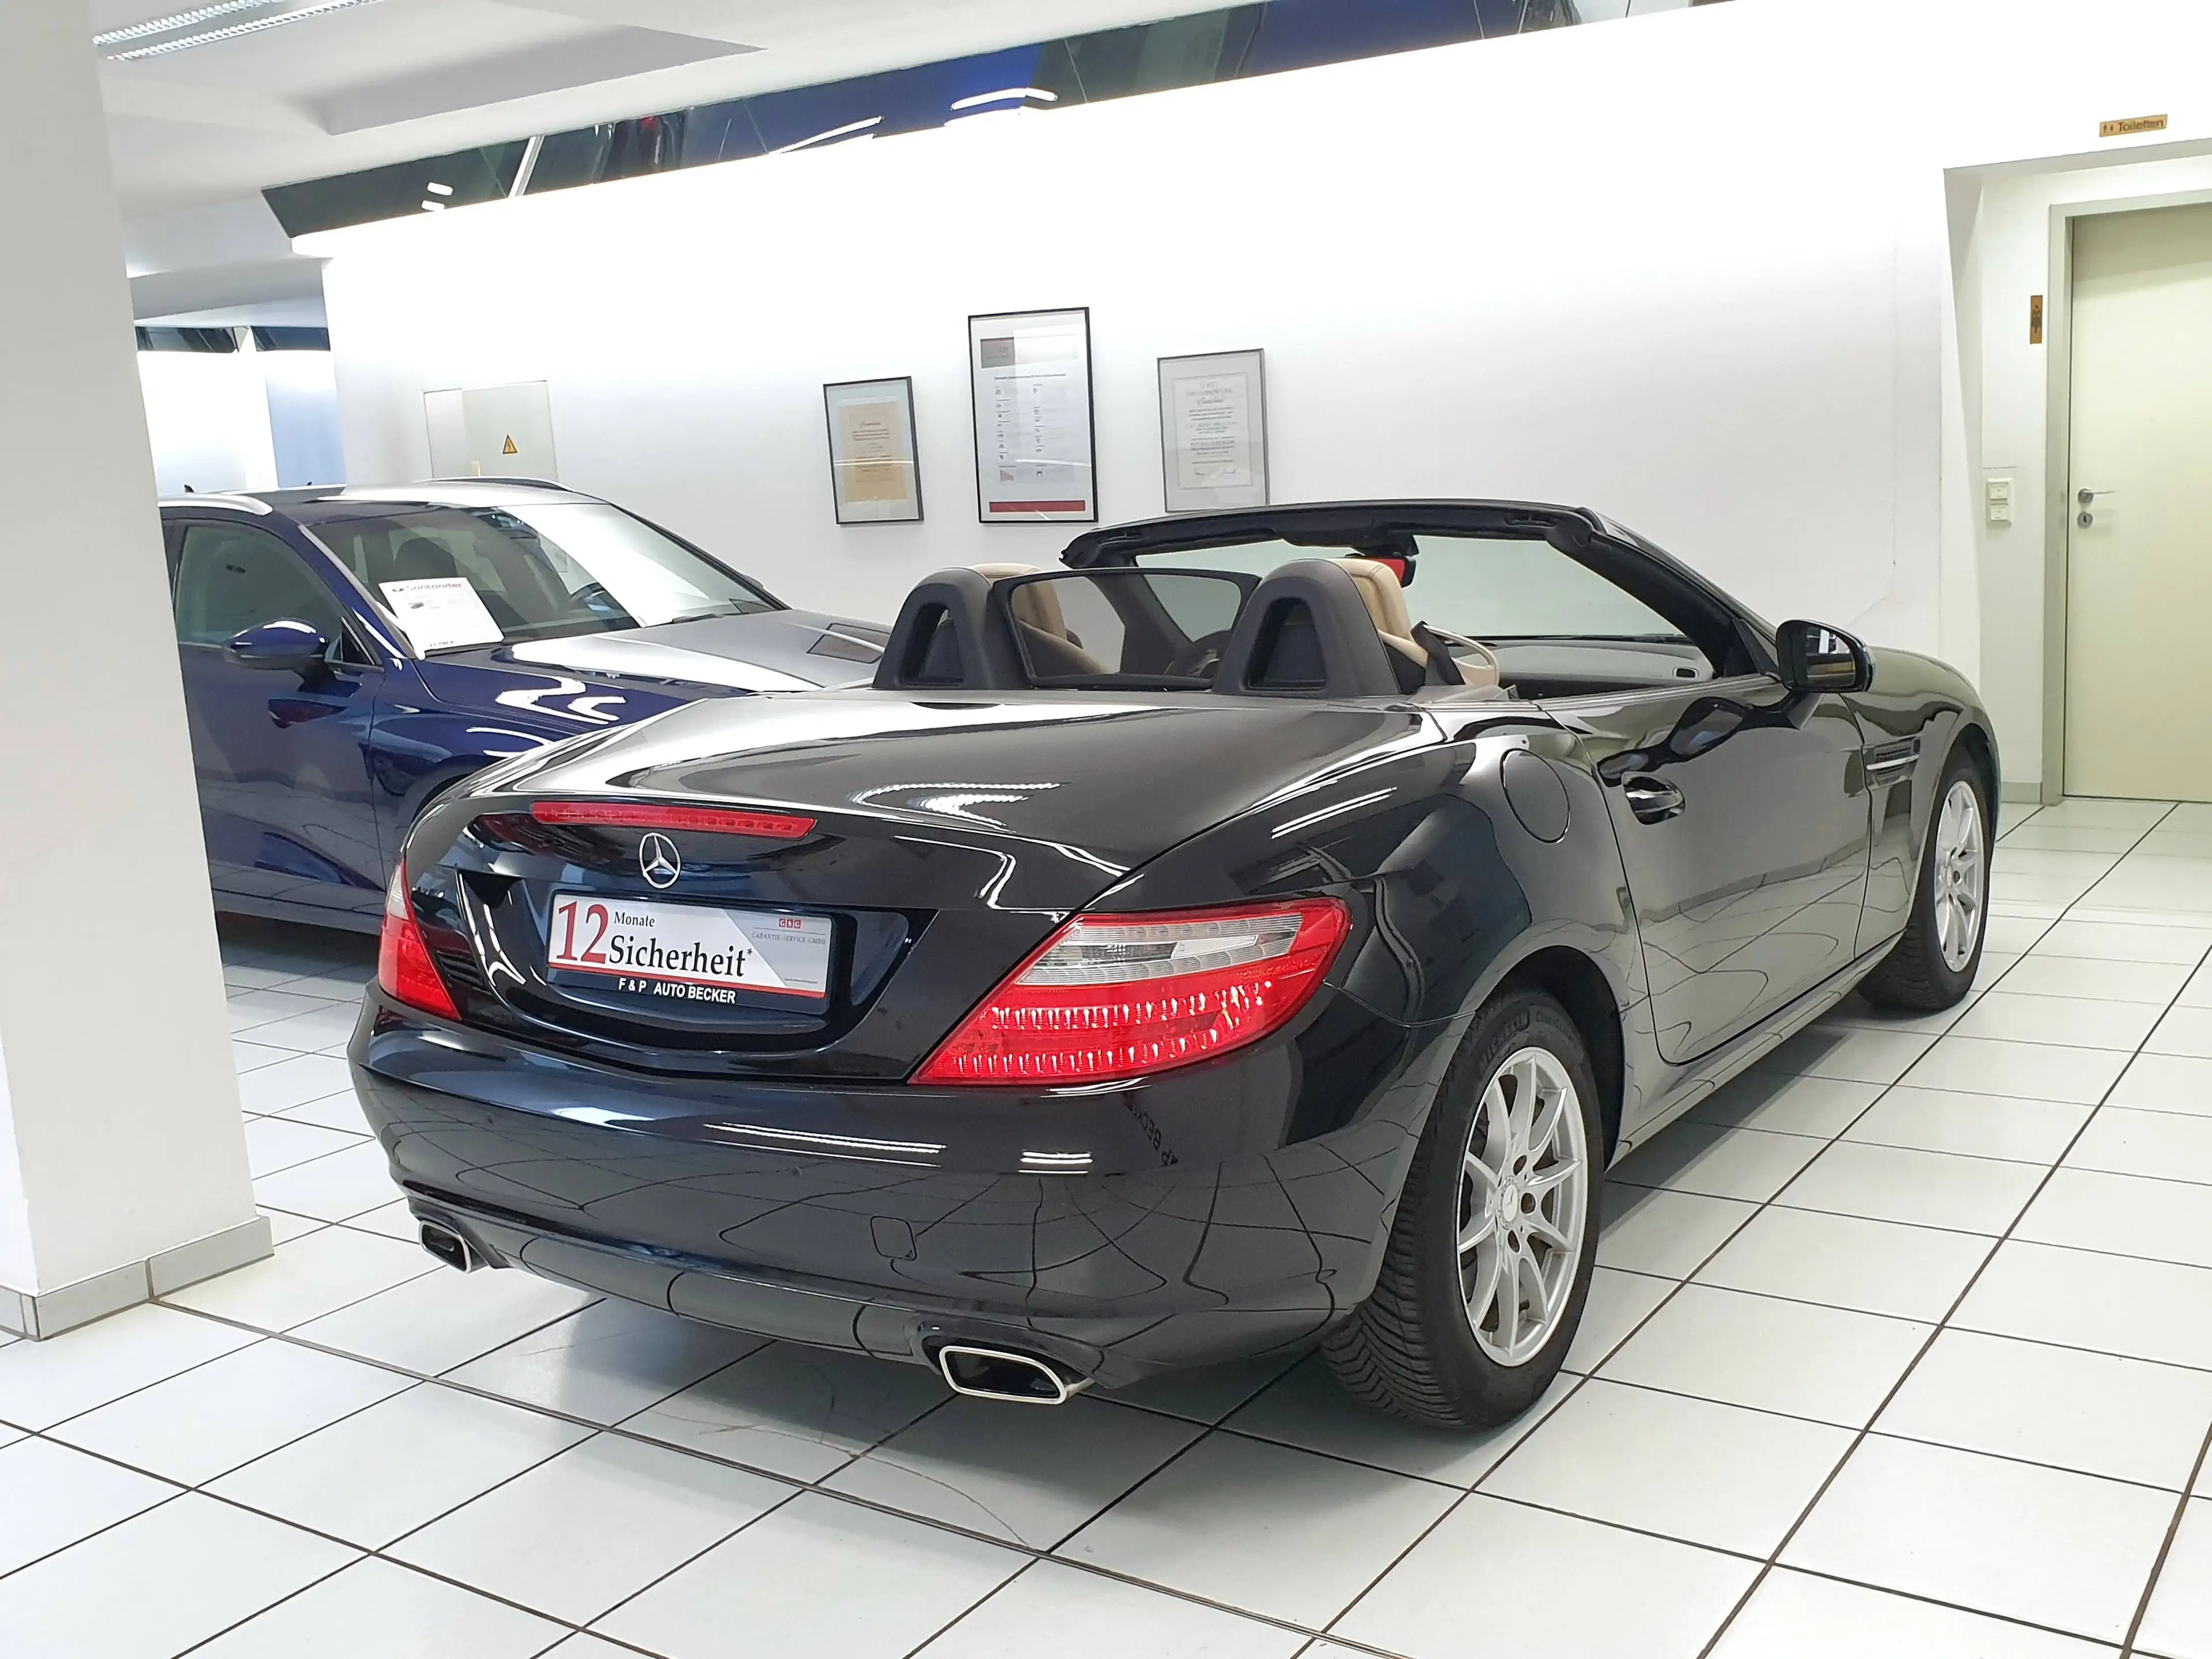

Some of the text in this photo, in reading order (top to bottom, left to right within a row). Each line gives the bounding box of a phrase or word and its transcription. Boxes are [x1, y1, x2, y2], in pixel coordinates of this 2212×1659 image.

[2117, 119, 2164, 132] Toiletten
[556, 901, 655, 964] 12 Monate
[779, 919, 801, 929] GSG
[618, 978, 736, 1004] F & P AUTO BECKER
